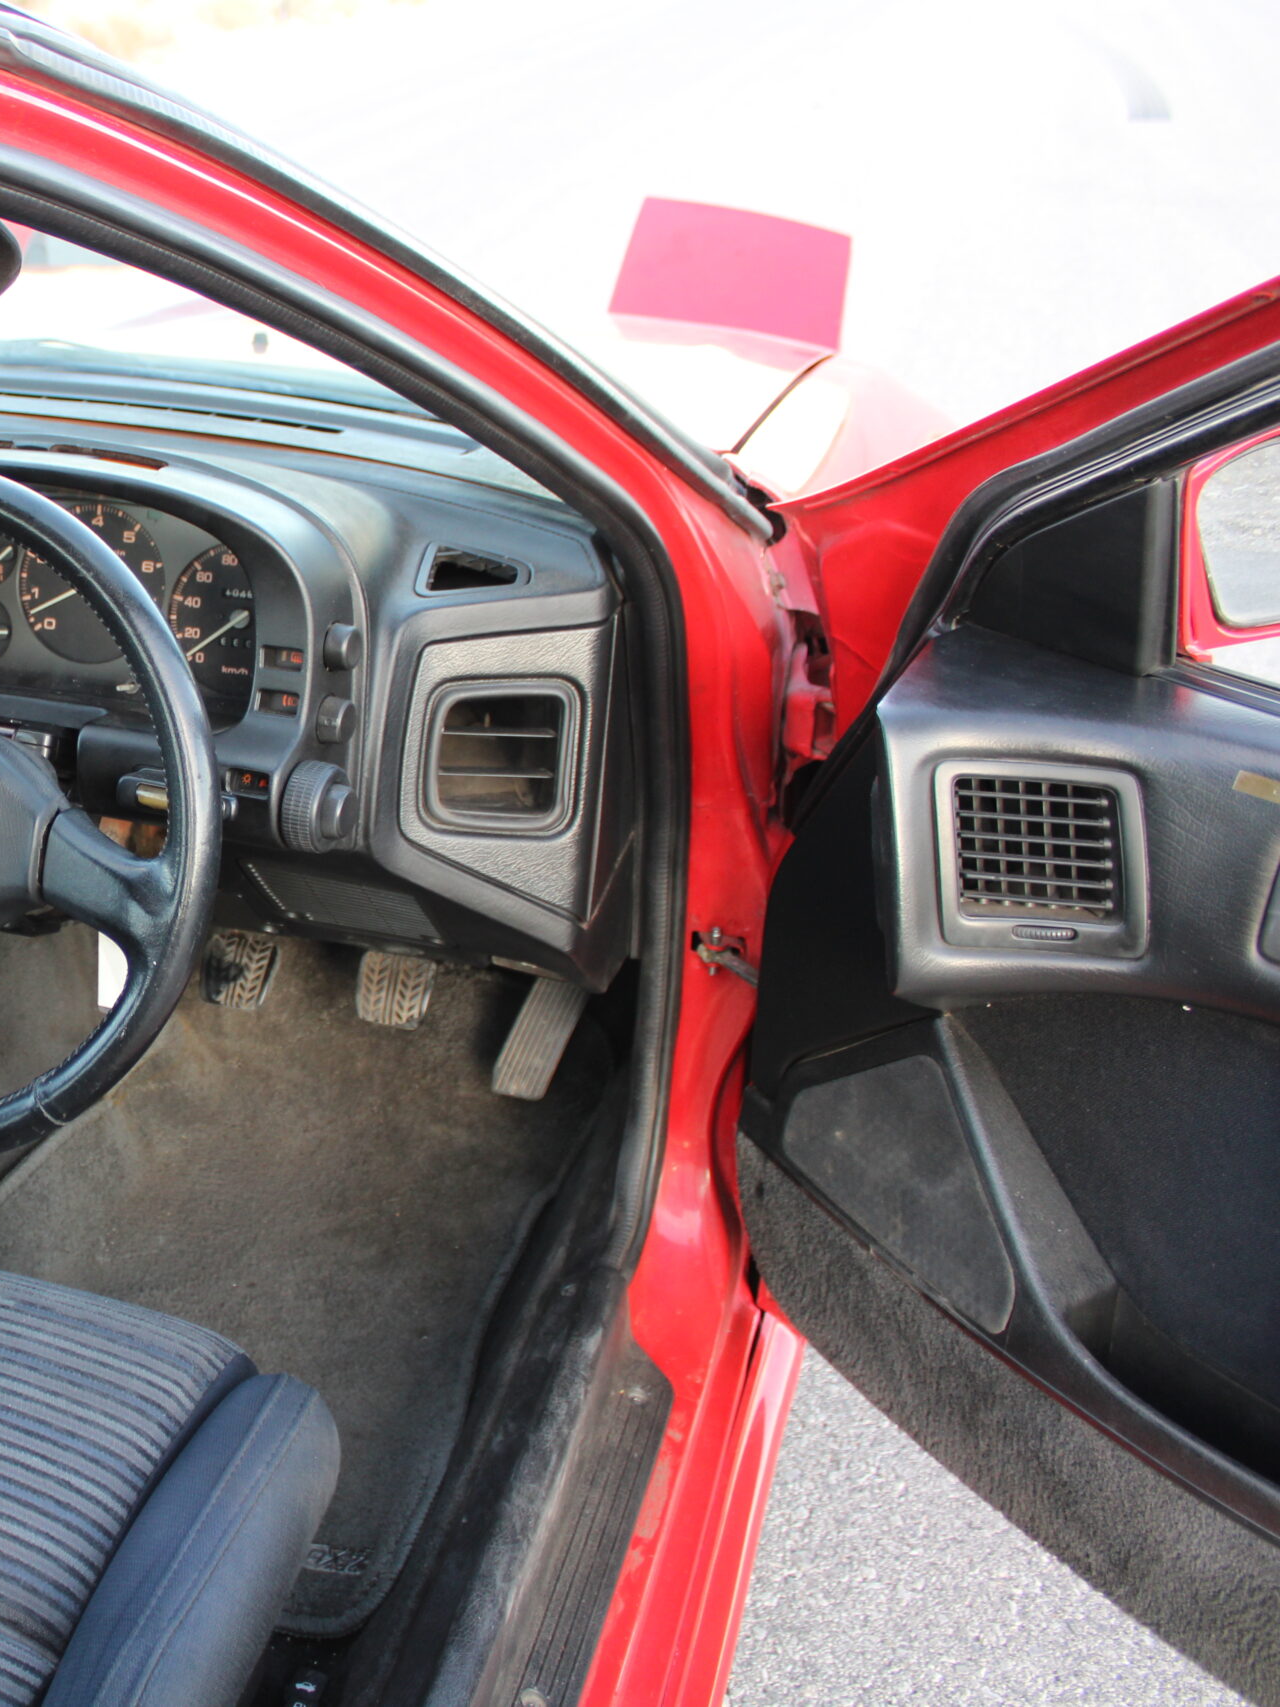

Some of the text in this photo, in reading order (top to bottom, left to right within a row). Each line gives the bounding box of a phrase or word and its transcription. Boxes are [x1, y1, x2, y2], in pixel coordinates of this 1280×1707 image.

[92, 515, 104, 527] 4
[123, 531, 135, 543] 5
[222, 554, 238, 566] 80
[141, 560, 154, 573] 6
[196, 572, 213, 583] 60
[31, 587, 39, 599] 1
[184, 597, 201, 608] 40
[43, 618, 56, 630] 0
[184, 627, 200, 638] 20
[195, 652, 204, 663] 0
[221, 665, 248, 676] km/h
